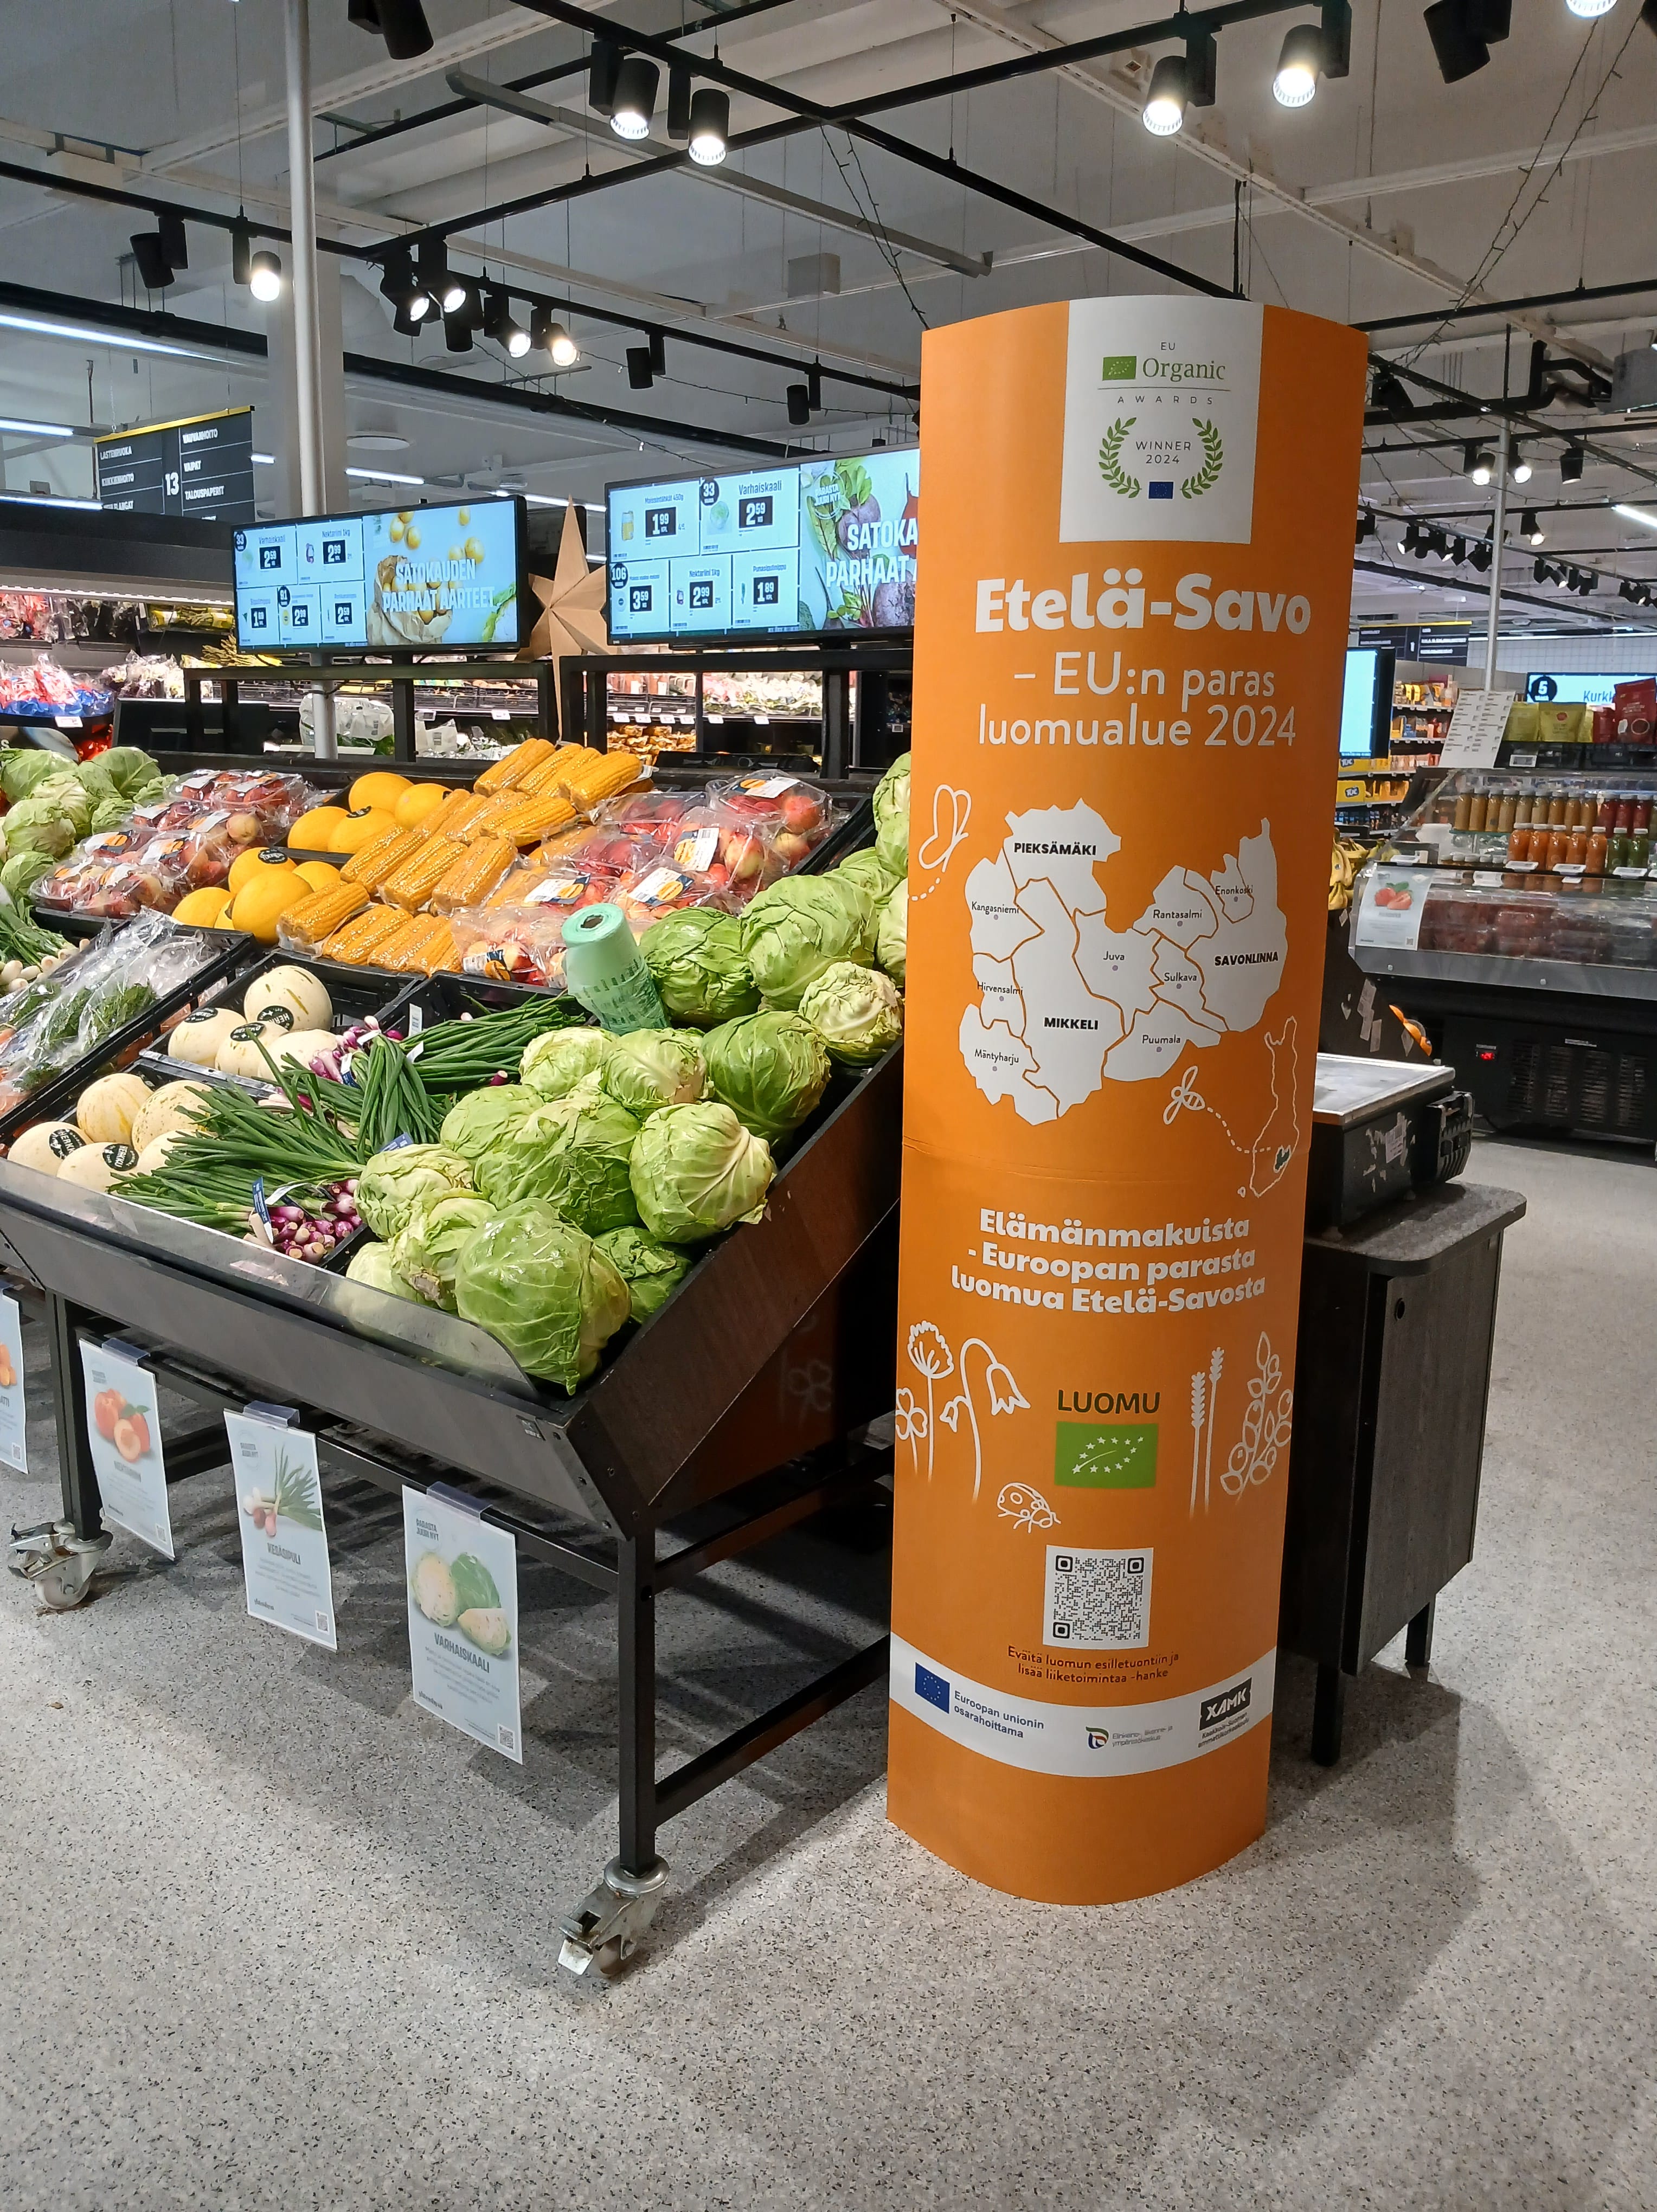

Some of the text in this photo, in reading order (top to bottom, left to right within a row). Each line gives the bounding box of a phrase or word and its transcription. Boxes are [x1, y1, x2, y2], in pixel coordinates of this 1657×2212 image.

[1160, 342, 1176, 351] EU
[1142, 357, 1226, 382] Organic
[1117, 395, 1213, 405] AWARDS
[1135, 440, 1192, 452] WINNER
[1146, 454, 1180, 465] 2024
[165, 472, 179, 496] 13
[703, 482, 715, 497] 33
[738, 480, 782, 496] Varhaiskaali
[184, 485, 225, 500] TALOUSPAPERIT
[396, 558, 476, 584] SATOKAUDEN
[612, 567, 627, 581] 106
[711, 568, 720, 577] 1kg
[826, 555, 910, 588] PARHAAT
[382, 586, 495, 613] PARHAAT AARTEET
[975, 568, 1311, 634] Etelä-Savo
[1054, 651, 1165, 696] EU:n
[1181, 668, 1275, 712] paras
[1538, 680, 1549, 695] 5
[978, 703, 1296, 747] luomualue 2024
[1346, 788, 1358, 797] TUC
[1013, 841, 1097, 857] PIEKSÄMÄKI
[1215, 885, 1253, 896] Enonkoski
[971, 901, 1020, 916] Kangasniemi
[1153, 909, 1203, 920] Rantasalmi
[1103, 950, 1125, 962] Juva
[1214, 951, 1279, 967] SAVONLINNA
[1164, 972, 1198, 982] Sulkava
[977, 981, 1023, 995] Hirvensalmi
[1044, 1017, 1099, 1031] MIKKELI
[1141, 1034, 1181, 1045] Puumala
[974, 1049, 1020, 1065] Mäntyharju
[980, 1207, 1250, 1248] Elämänmakuista
[1146, 1248, 1256, 1285] parasta
[950, 1264, 1267, 1314] luomua Etelä-Savosta
[1057, 1389, 1161, 1414] LUOMU
[434, 1632, 490, 1674] VARHAISKAALI
[1007, 1645, 1179, 1669] Eväitä luomun esilletuontiin ja
[1018, 1663, 1168, 1683] lisää liiketoimintaa -hanke
[954, 1690, 1044, 1729] Euroopan unionin
[1205, 1687, 1247, 1721] XAMK
[954, 1706, 1024, 1739] osarahoittama
